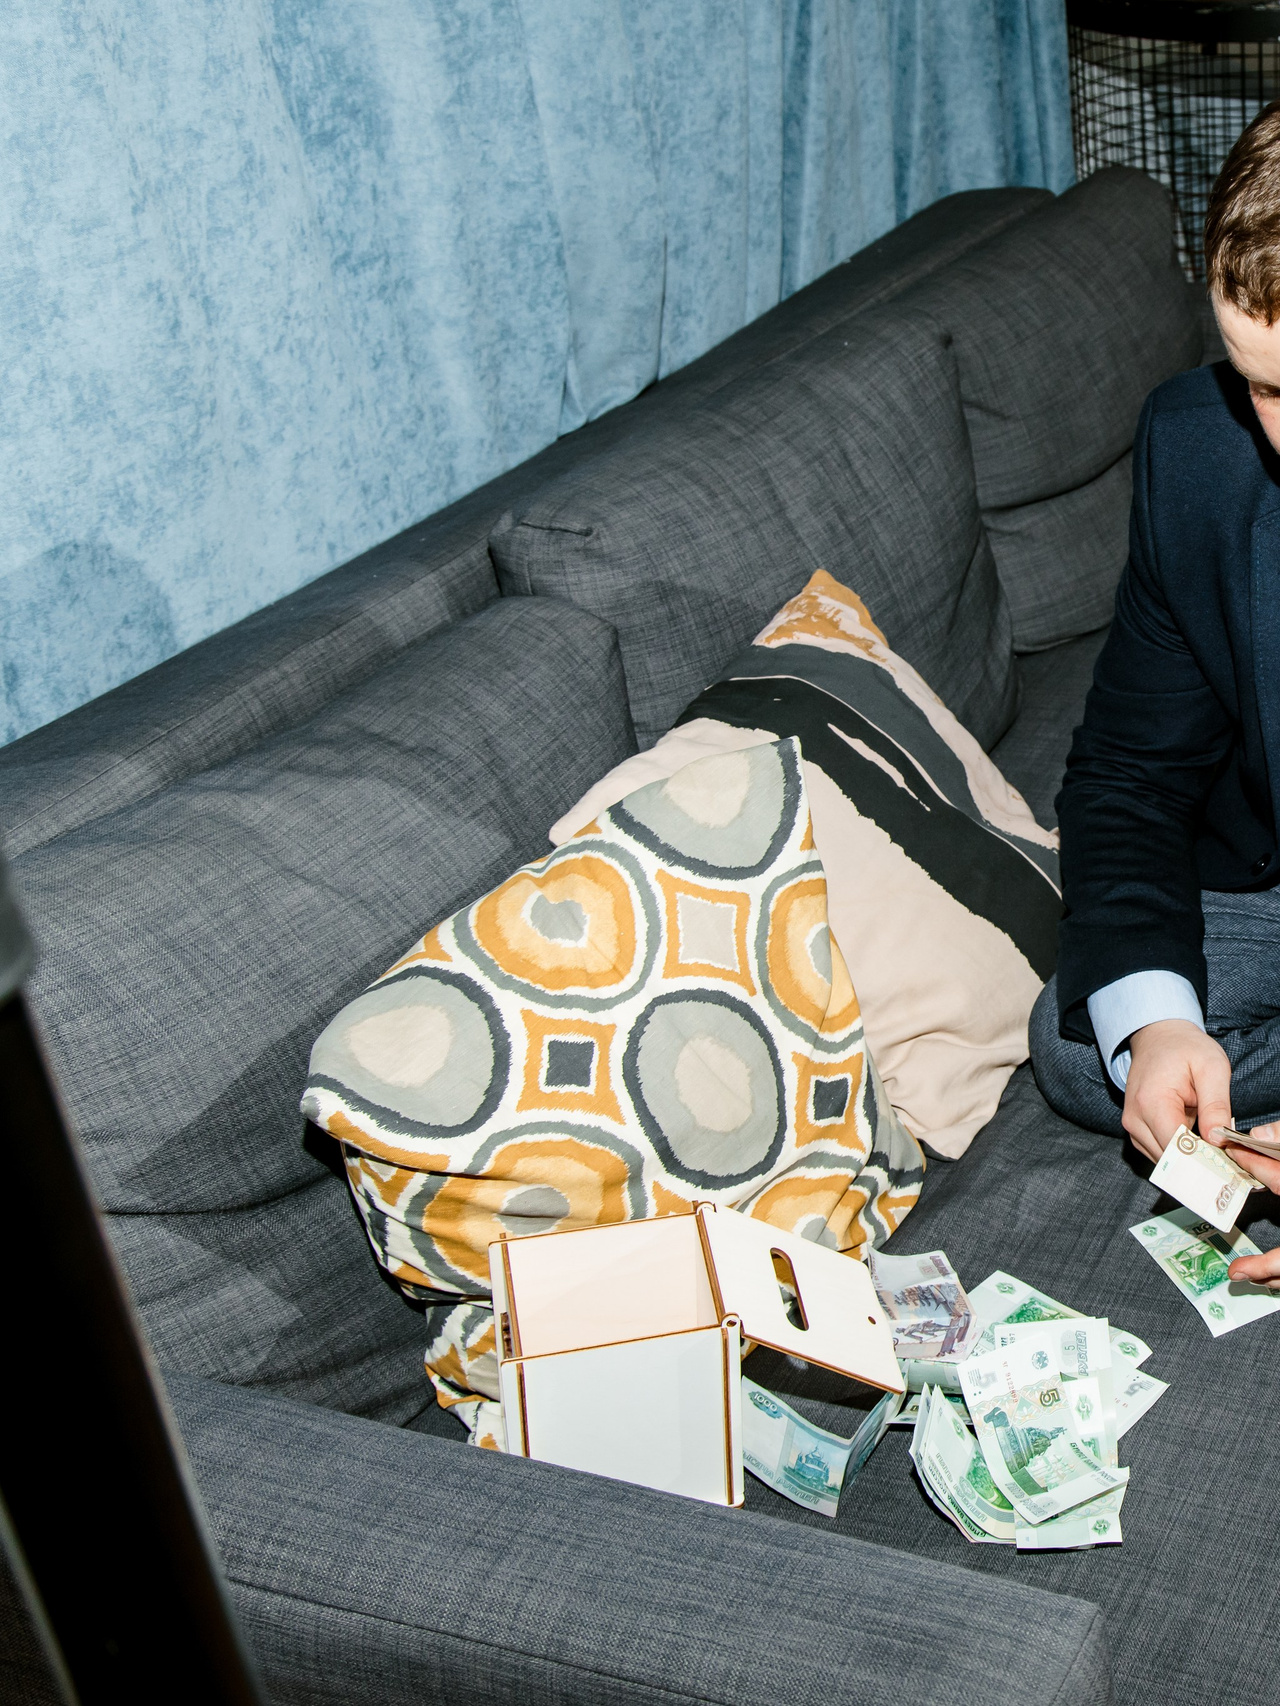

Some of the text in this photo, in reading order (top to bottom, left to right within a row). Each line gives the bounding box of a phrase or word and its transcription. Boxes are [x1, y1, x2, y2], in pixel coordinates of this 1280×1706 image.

[1217, 1182, 1238, 1212] 100
[753, 1392, 778, 1413] 1000
[1040, 1387, 1061, 1407] 5
